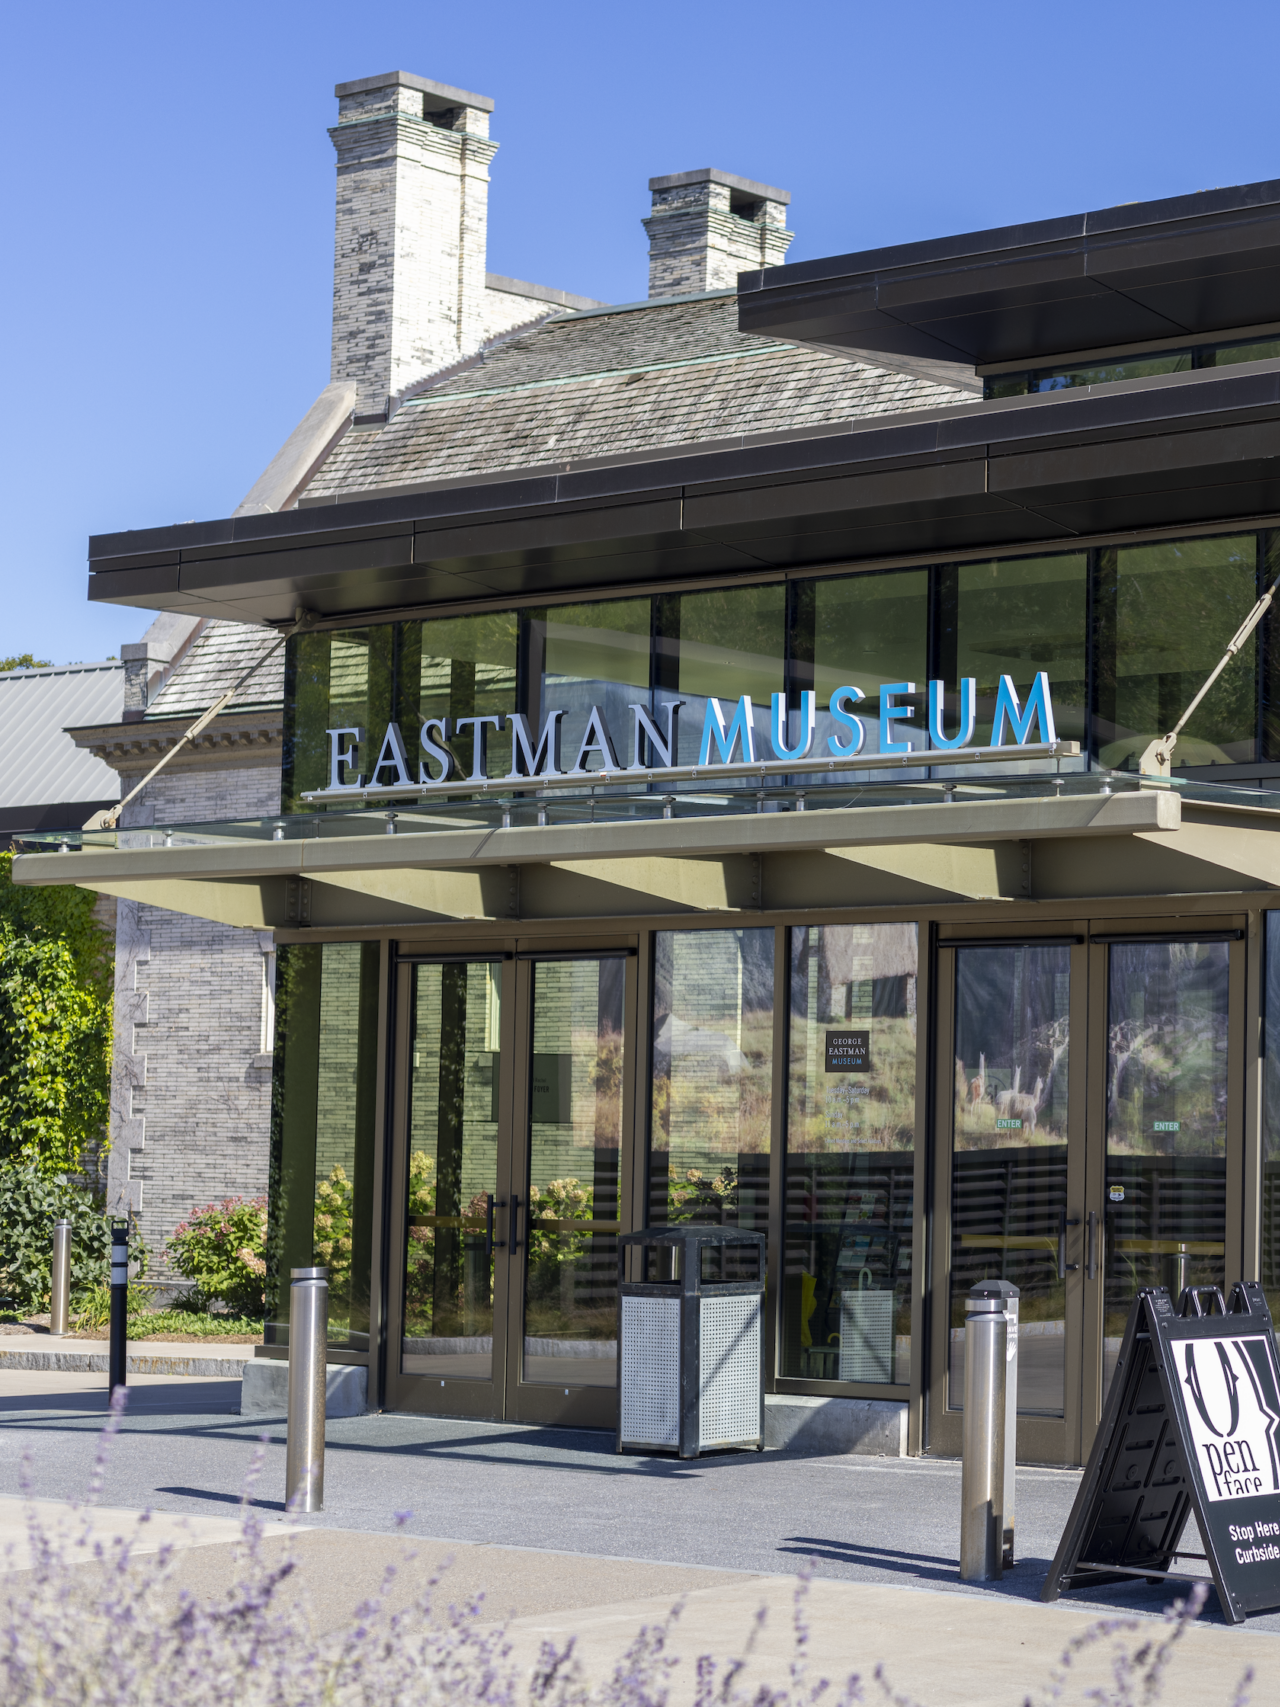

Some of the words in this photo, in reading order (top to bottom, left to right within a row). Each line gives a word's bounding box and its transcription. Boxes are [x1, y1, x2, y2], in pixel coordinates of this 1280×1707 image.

[327, 700, 684, 790] EASTMAN
[698, 671, 1057, 764] MUSEUM
[997, 1120, 1021, 1128] ENTER
[1154, 1122, 1179, 1131] ENTER
[1229, 1525, 1254, 1542] Stop
[1255, 1521, 1280, 1537] Here
[1236, 1543, 1280, 1564] Curbside
